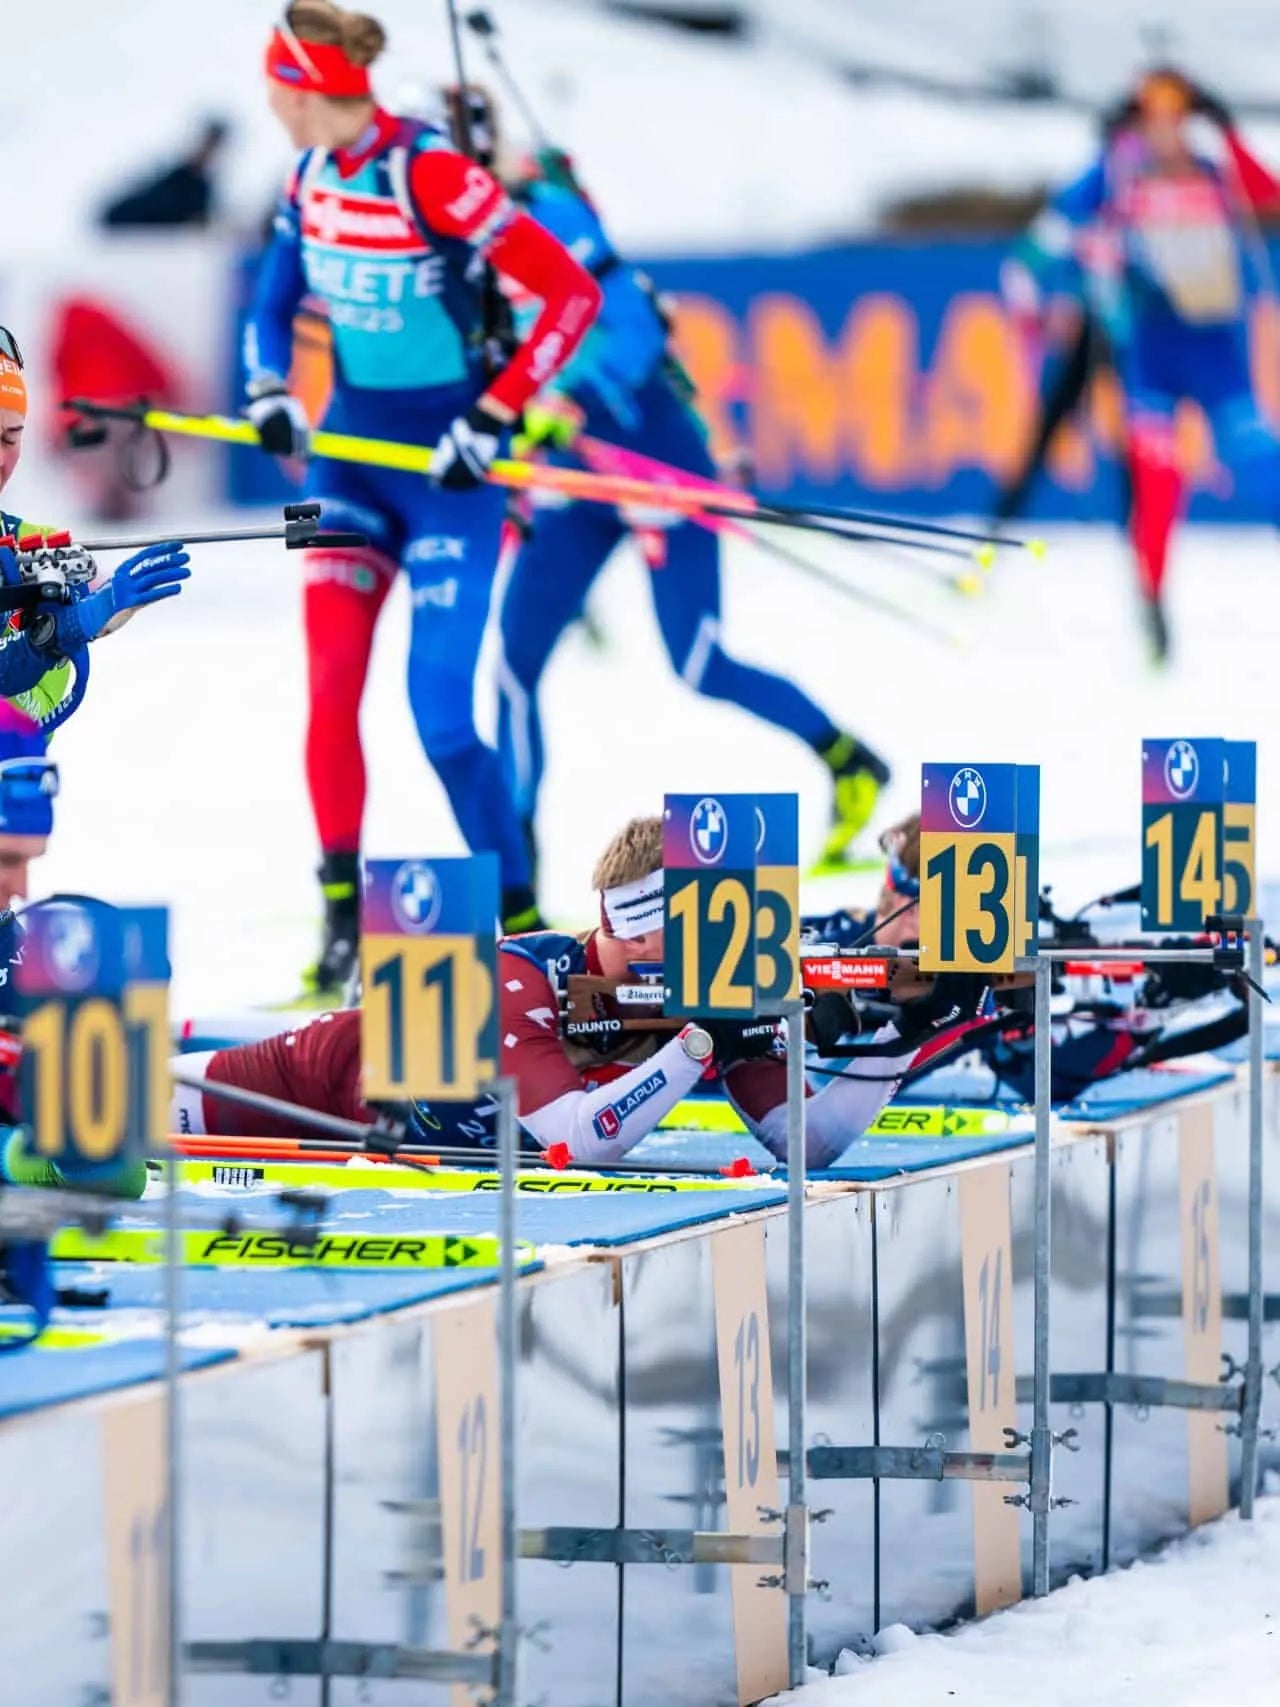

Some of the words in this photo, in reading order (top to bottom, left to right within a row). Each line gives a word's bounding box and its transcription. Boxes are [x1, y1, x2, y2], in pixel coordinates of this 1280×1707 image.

[926, 842, 1010, 964] 13
[1145, 811, 1221, 926] 14
[669, 878, 754, 1008] 12
[22, 997, 128, 1160] 10
[372, 952, 456, 1086] 11
[567, 1020, 621, 1034] SUUNTO
[616, 1076, 664, 1116] LAPUA
[202, 1235, 428, 1262] FISCHER
[978, 1246, 1003, 1415] 14
[734, 1311, 761, 1489] 13
[456, 1392, 487, 1584] 12
